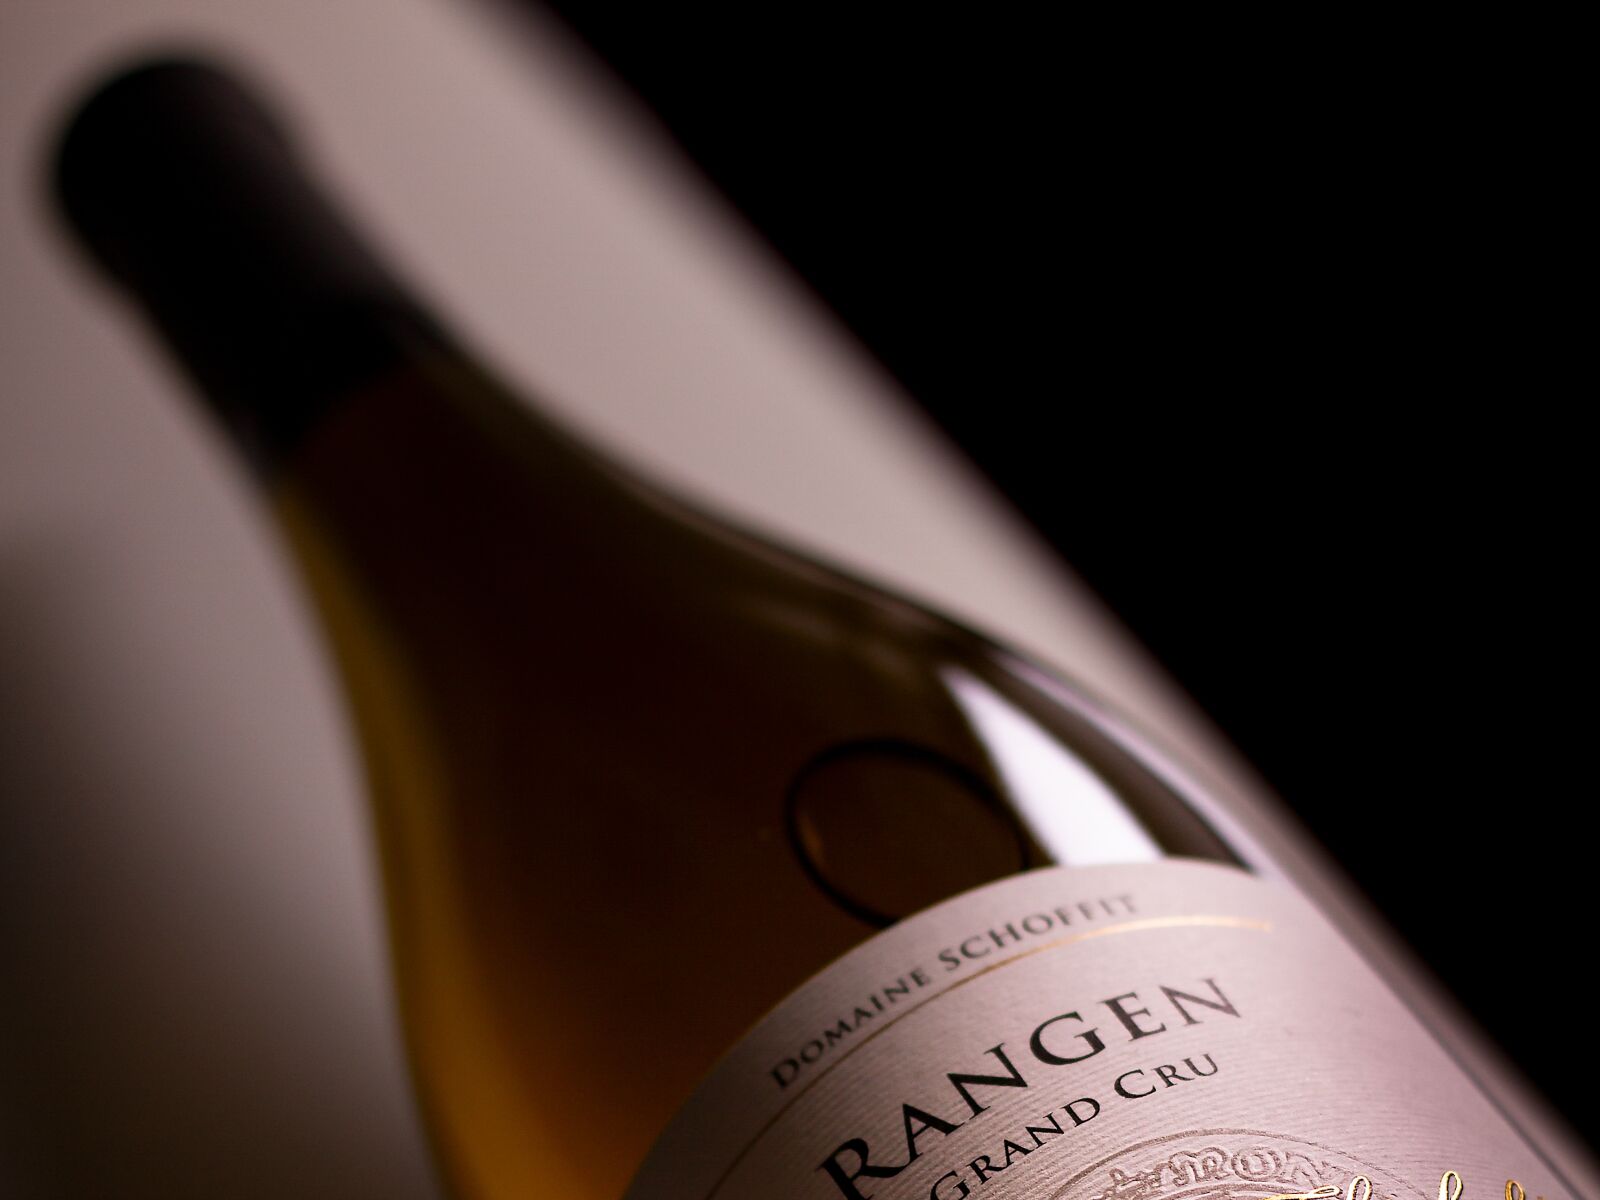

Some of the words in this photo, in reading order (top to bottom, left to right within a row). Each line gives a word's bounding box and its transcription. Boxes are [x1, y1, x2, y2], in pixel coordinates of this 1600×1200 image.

[770, 966, 932, 1090] DOMAINE
[938, 893, 1139, 972] SCHOFFIT
[1113, 1053, 1219, 1100] CRU
